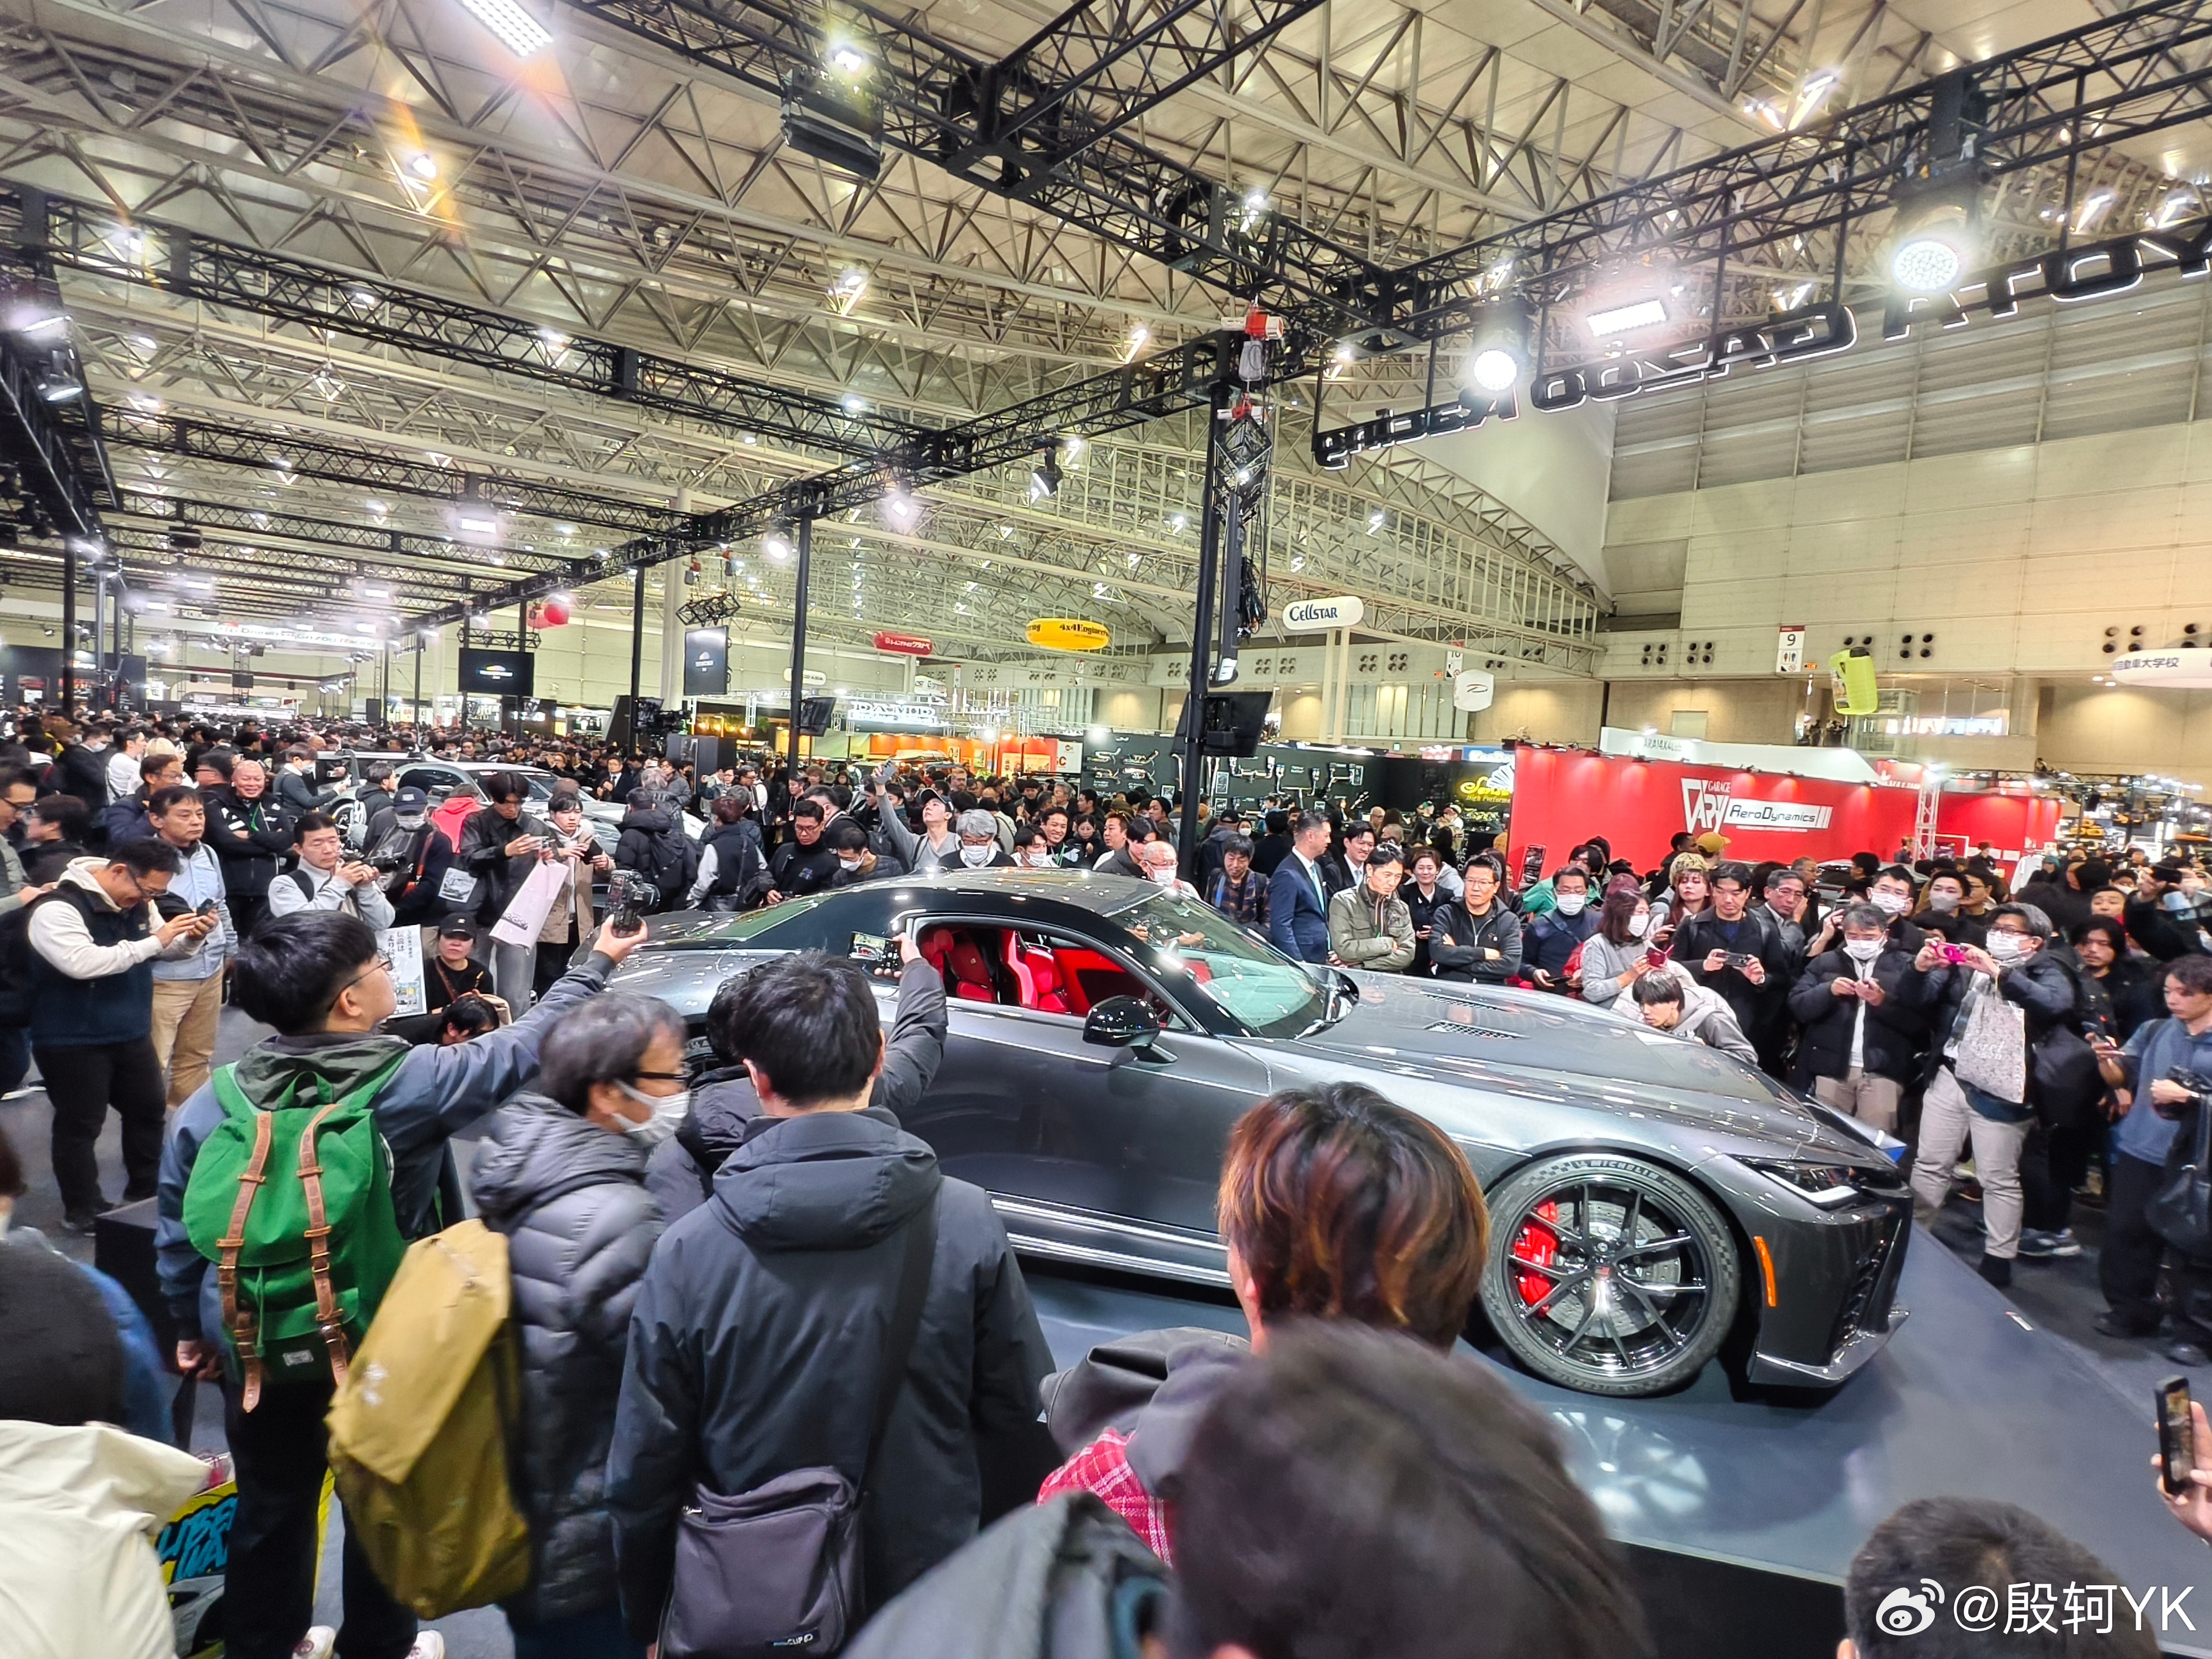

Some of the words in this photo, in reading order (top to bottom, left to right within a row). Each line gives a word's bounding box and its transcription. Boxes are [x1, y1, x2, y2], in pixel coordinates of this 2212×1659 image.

[1787, 633, 1796, 646] 9
[1708, 780, 1731, 793] GARAGE
[1729, 805, 1816, 823] AeroDynamics
[1591, 1160, 1660, 1180] MICHELIN
